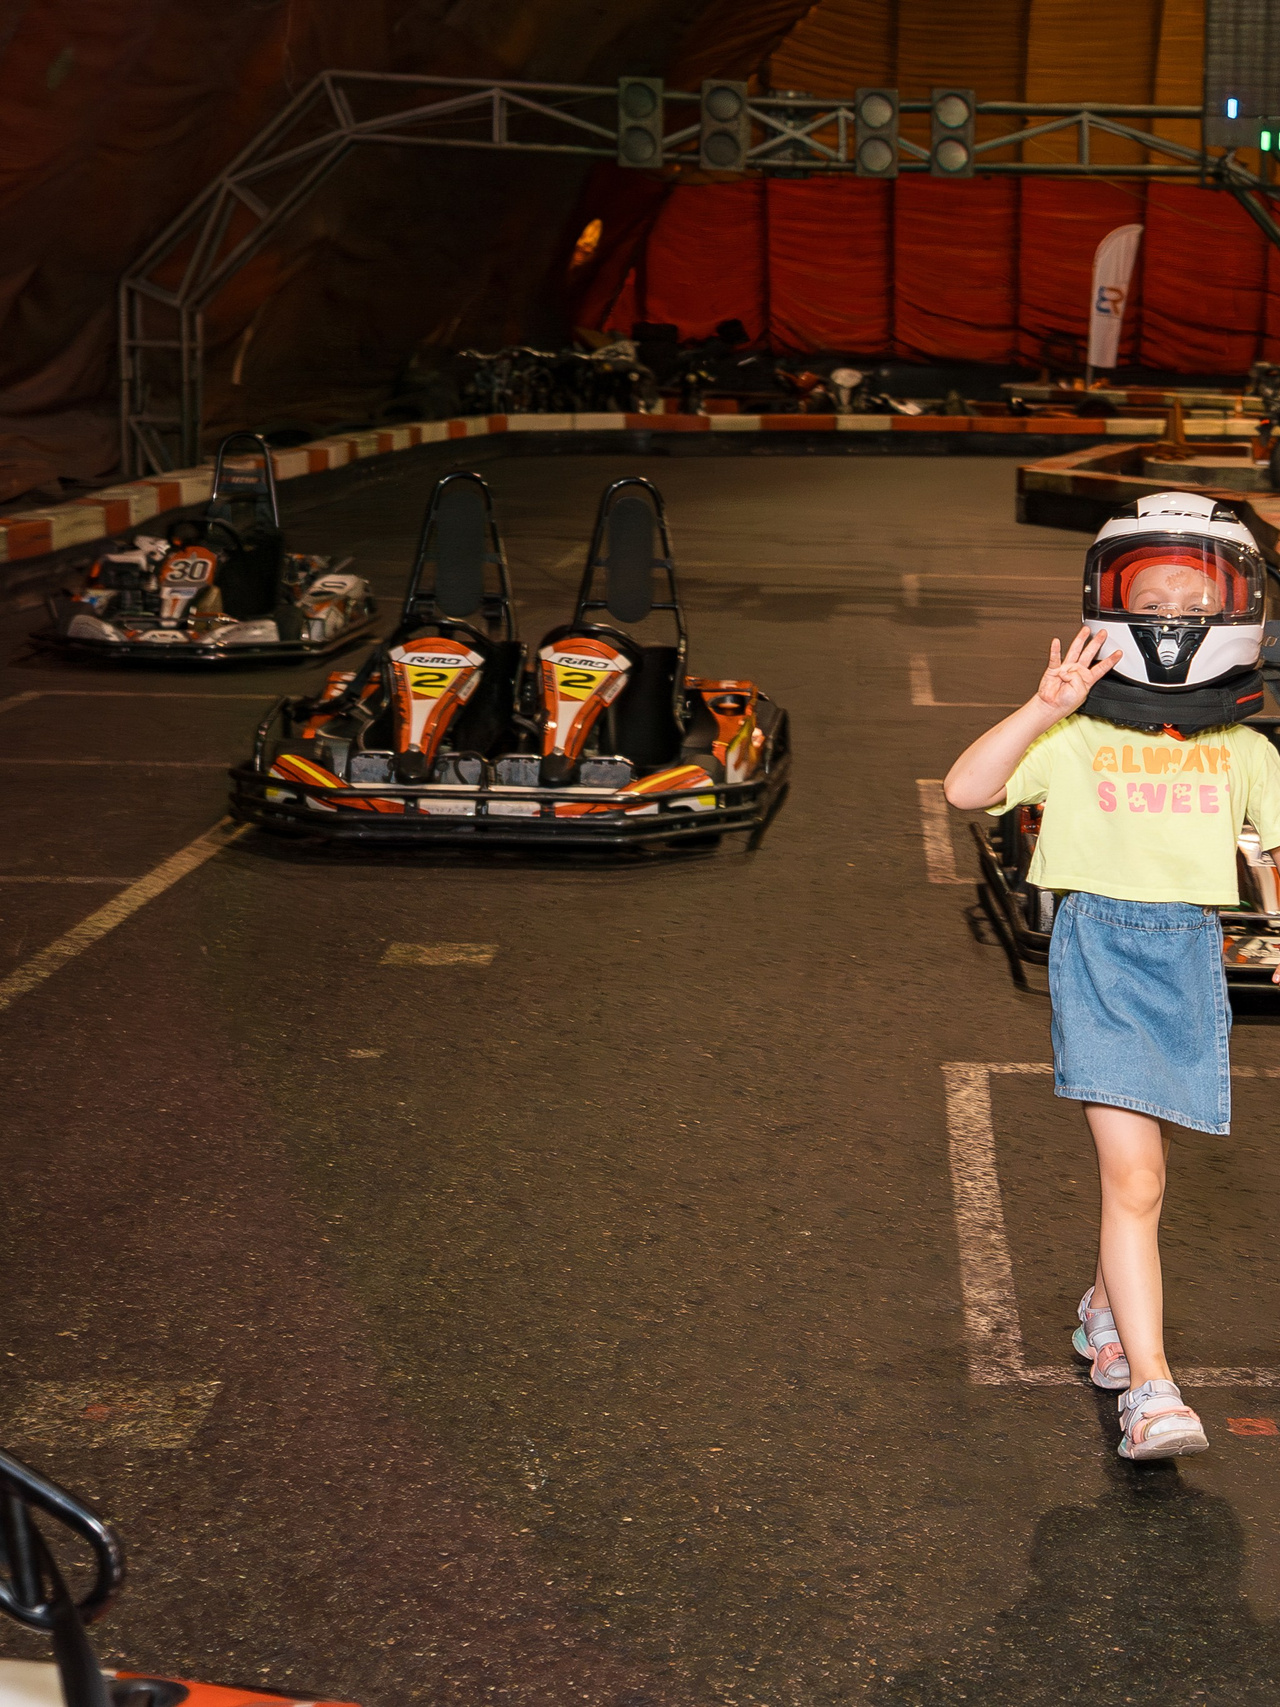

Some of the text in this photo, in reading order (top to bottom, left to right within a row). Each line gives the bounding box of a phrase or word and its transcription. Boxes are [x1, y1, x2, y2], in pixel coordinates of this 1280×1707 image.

[168, 560, 209, 581] 30
[411, 671, 448, 688] 2
[560, 672, 596, 689] 2
[1097, 781, 1230, 813] SWEE
